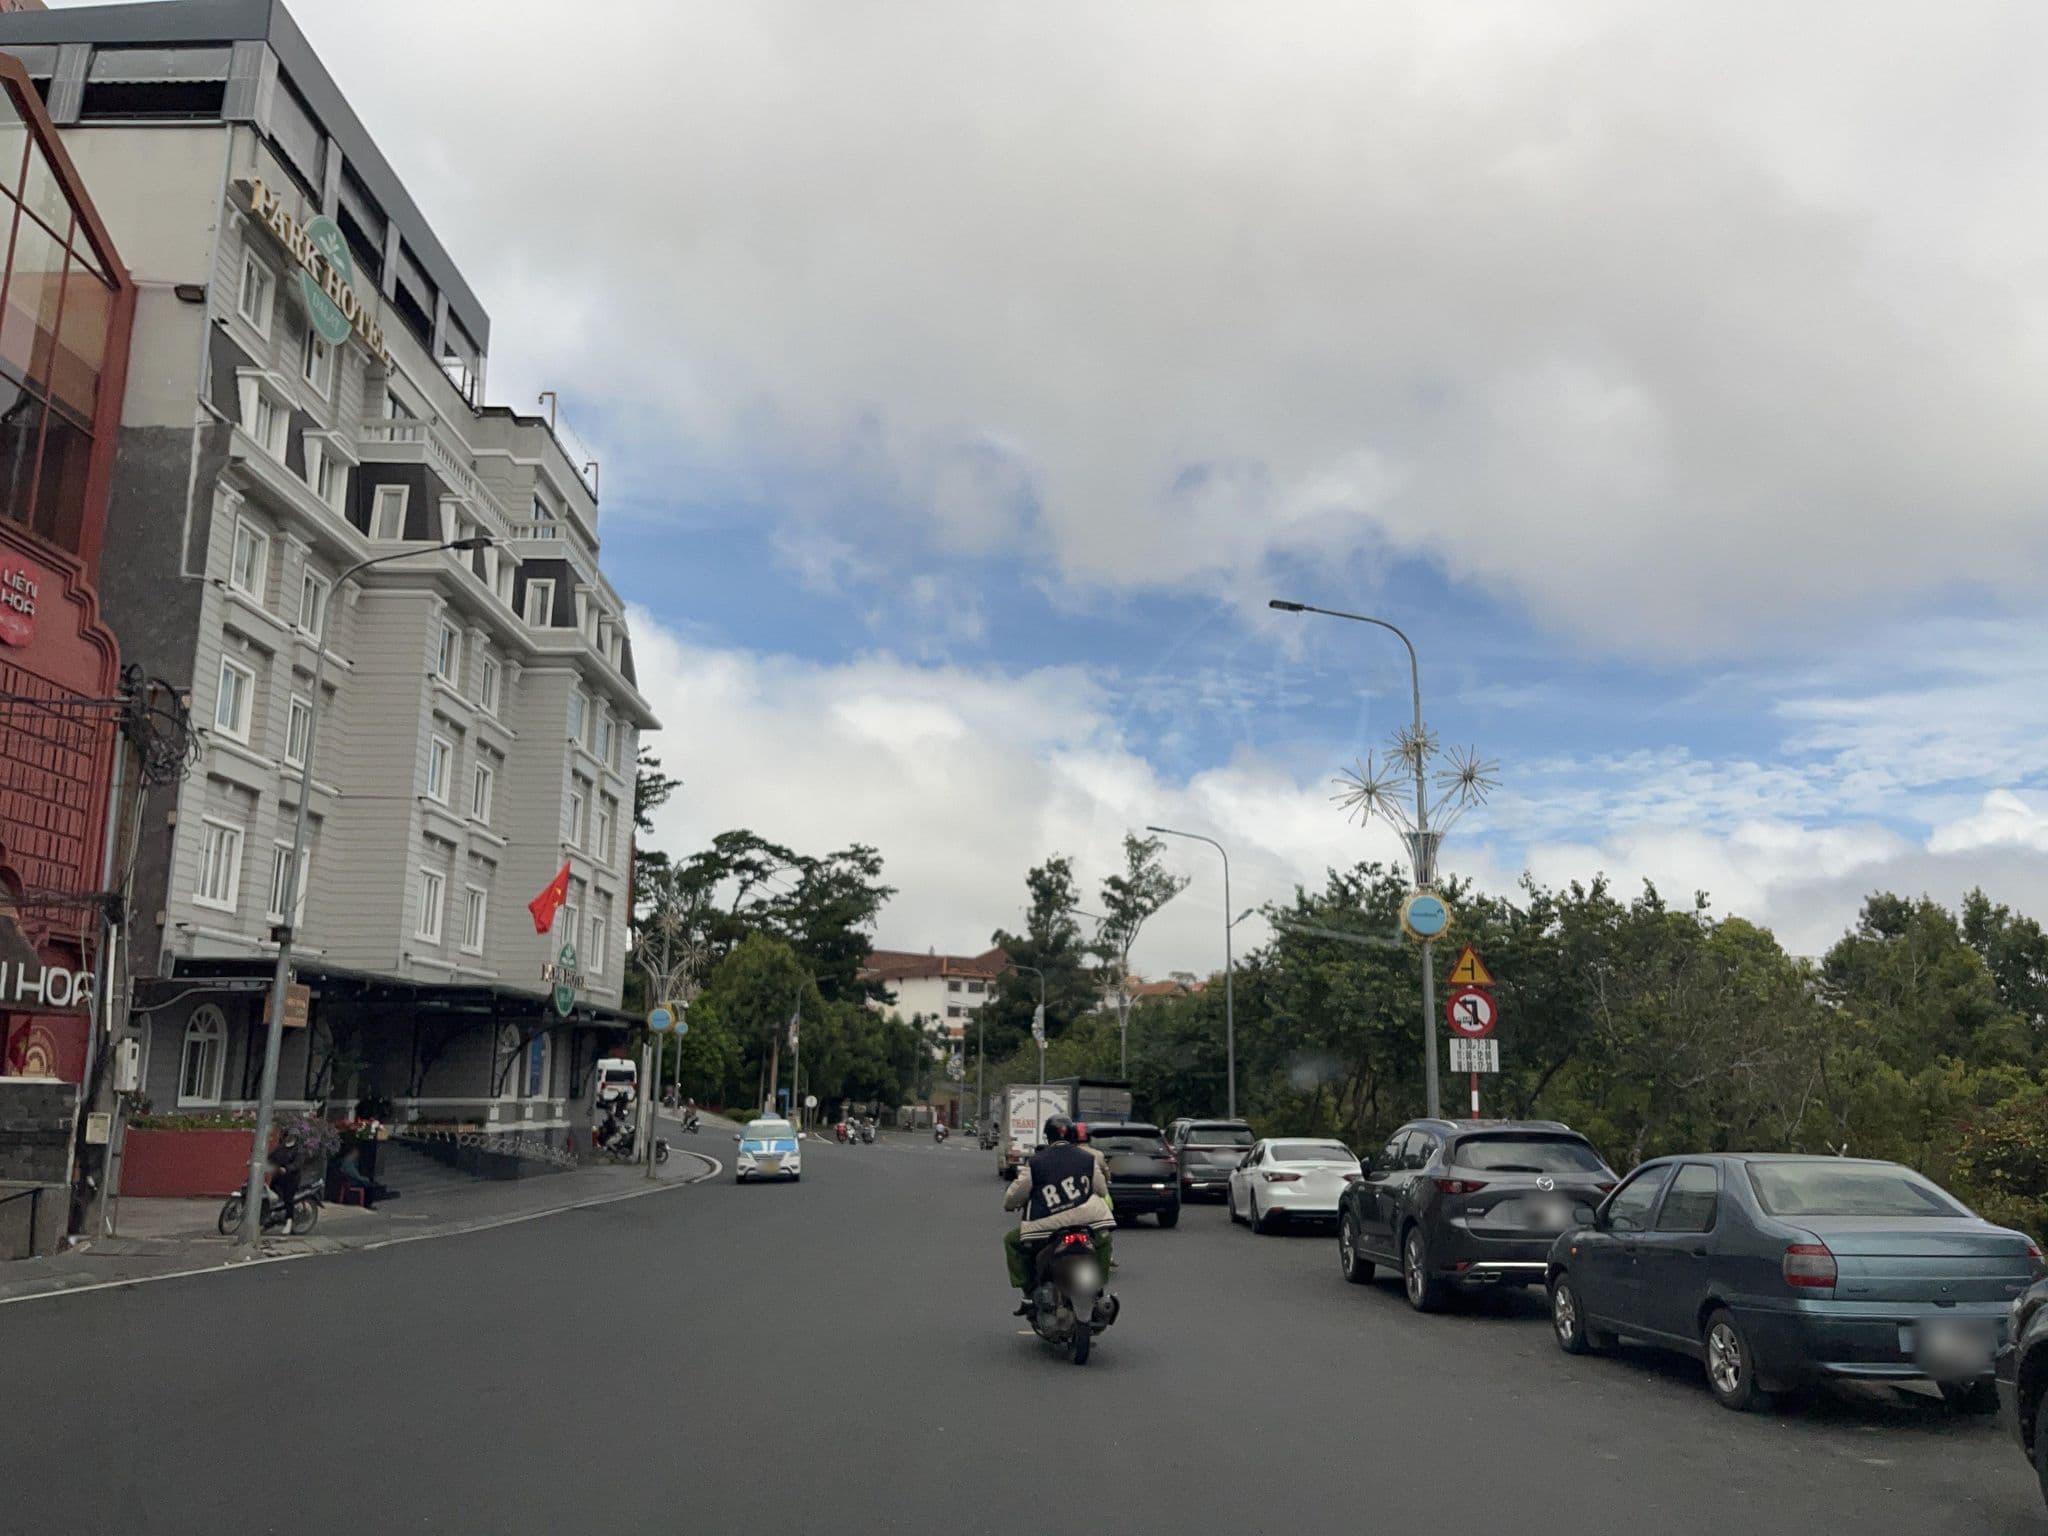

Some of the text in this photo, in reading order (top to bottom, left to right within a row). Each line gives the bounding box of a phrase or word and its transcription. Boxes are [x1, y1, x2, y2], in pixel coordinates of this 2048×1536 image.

[252, 176, 395, 365] PARK HOTEL
[3, 569, 38, 598] LIÊN
